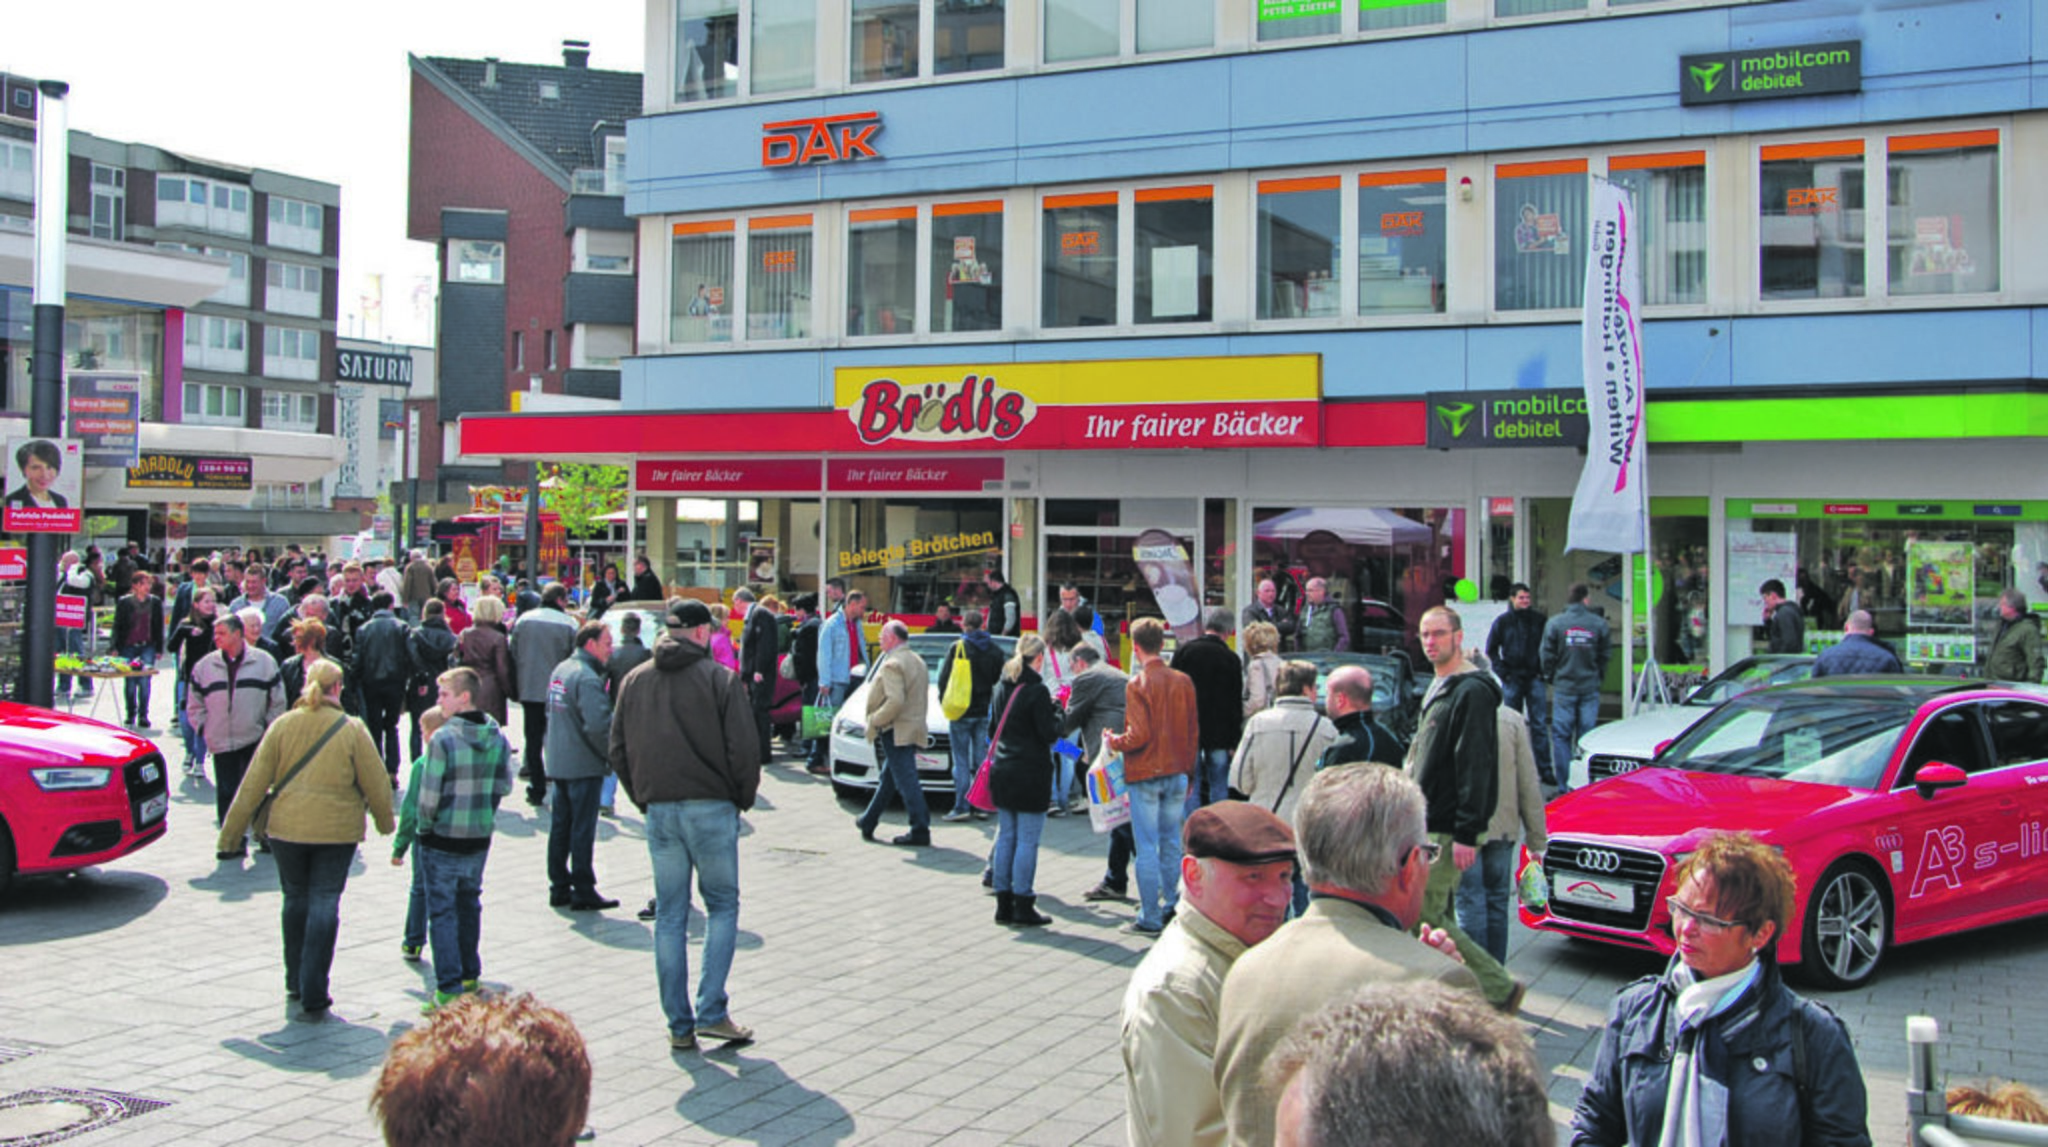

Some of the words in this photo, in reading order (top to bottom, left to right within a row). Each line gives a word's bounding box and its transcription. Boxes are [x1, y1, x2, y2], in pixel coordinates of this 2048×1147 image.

[1741, 50, 1850, 72] mobilcom
[1741, 71, 1803, 91] debitel
[762, 111, 879, 167] DAK
[1787, 188, 1839, 206] DAK
[1381, 211, 1424, 229] DAK
[339, 353, 411, 382] SATURN
[858, 375, 1025, 443] Brödis
[1493, 394, 1588, 415] mobilco
[1084, 415, 1125, 438] Ihr
[1131, 413, 1206, 441] fairer
[1212, 411, 1304, 437] Bäcker
[1493, 419, 1563, 438] debitel
[652, 470, 669, 481] Ihr
[671, 469, 703, 483] fairer
[704, 469, 743, 482] Bäcker
[847, 469, 865, 482] Ihr
[868, 468, 902, 483] fairer
[906, 467, 948, 482] Bäcker
[839, 545, 905, 568] Belegte
[911, 530, 994, 556] Brötchen
[1909, 825, 1966, 898] A3
[1974, 821, 2048, 870] s-li
